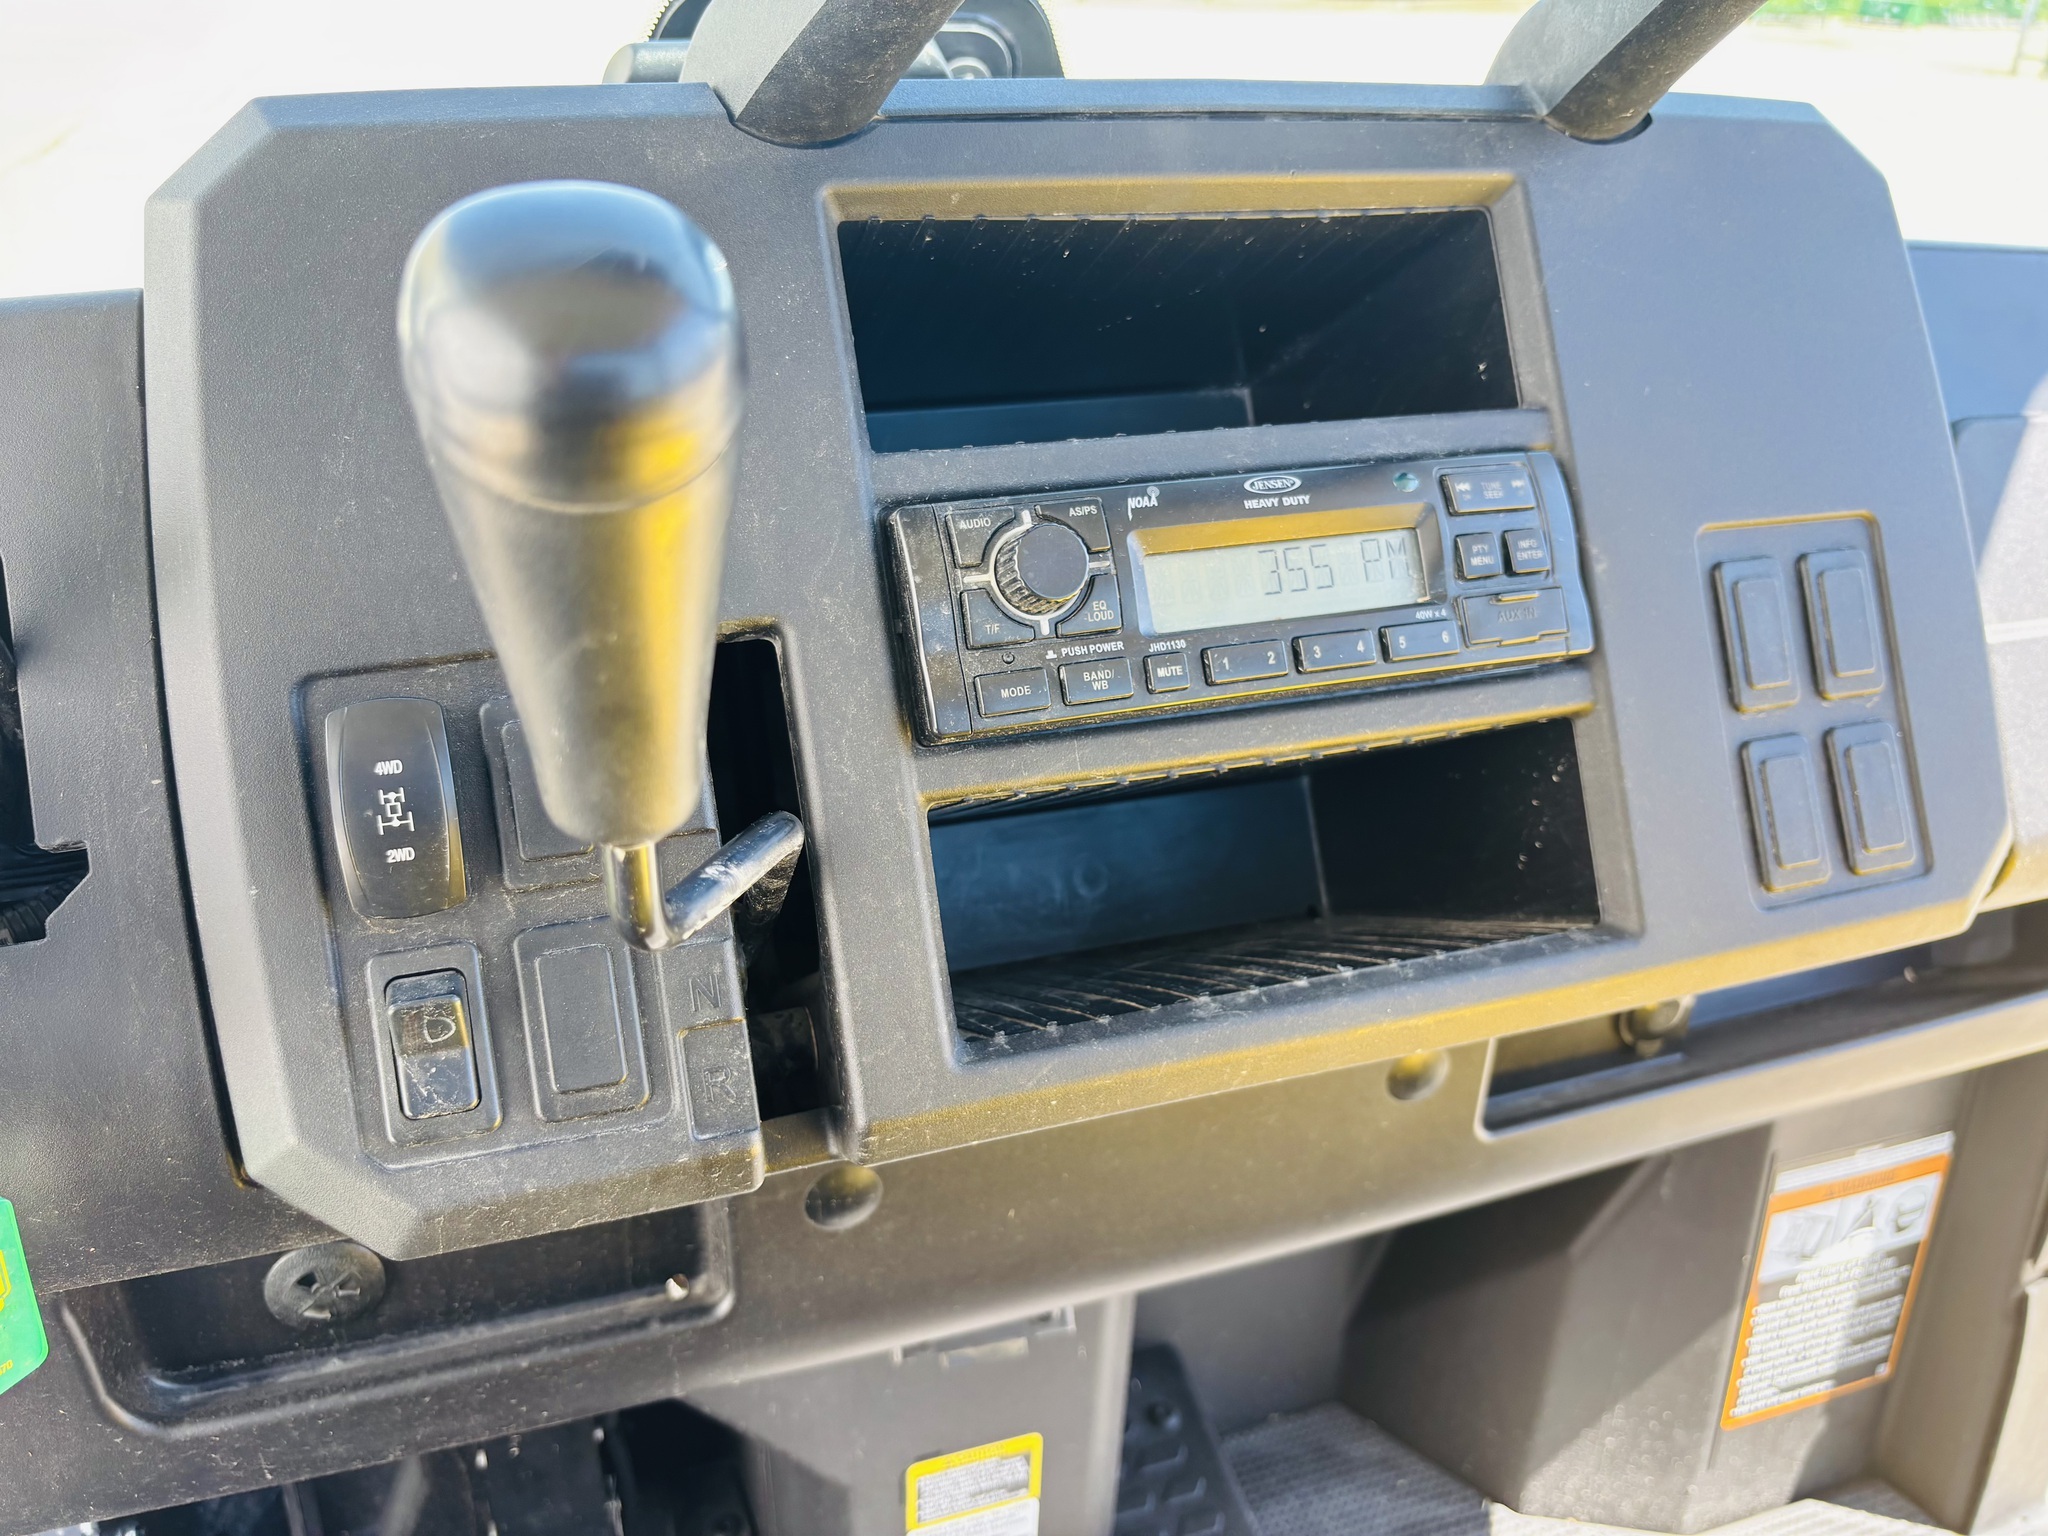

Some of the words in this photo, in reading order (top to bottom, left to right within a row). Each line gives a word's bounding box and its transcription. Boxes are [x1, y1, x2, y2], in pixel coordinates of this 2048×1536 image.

[1244, 498, 1280, 509] HEAVY
[1282, 495, 1311, 506] DUTY
[1069, 505, 1098, 517] AS/PS
[960, 517, 991, 528] AUDIO
[1517, 539, 1538, 549] INFO
[1361, 538, 1408, 583] PM
[1470, 555, 1495, 566] MENU
[1516, 550, 1543, 561] ENTER
[1093, 600, 1107, 611] EQ
[1088, 610, 1114, 622] LOUD
[1415, 610, 1434, 620] 40W
[1440, 609, 1446, 617] 4
[985, 624, 1000, 634] T/F
[1399, 636, 1406, 649] 5
[1441, 631, 1449, 643] 6
[1061, 646, 1087, 657] PUSH
[1089, 642, 1124, 654] POWER
[1148, 641, 1186, 653] JHD1130
[1313, 646, 1322, 658] 3
[1356, 641, 1365, 653] 4
[1222, 657, 1230, 671] 1
[1267, 651, 1276, 664] 2
[1083, 669, 1115, 682] BAND/
[1156, 667, 1183, 677] MUTE
[1000, 686, 1031, 698] MODE
[1092, 681, 1109, 691] WB
[374, 759, 403, 776] 4WD
[386, 846, 416, 863] 2WD
[689, 973, 723, 1013] N
[701, 1066, 735, 1102] R
